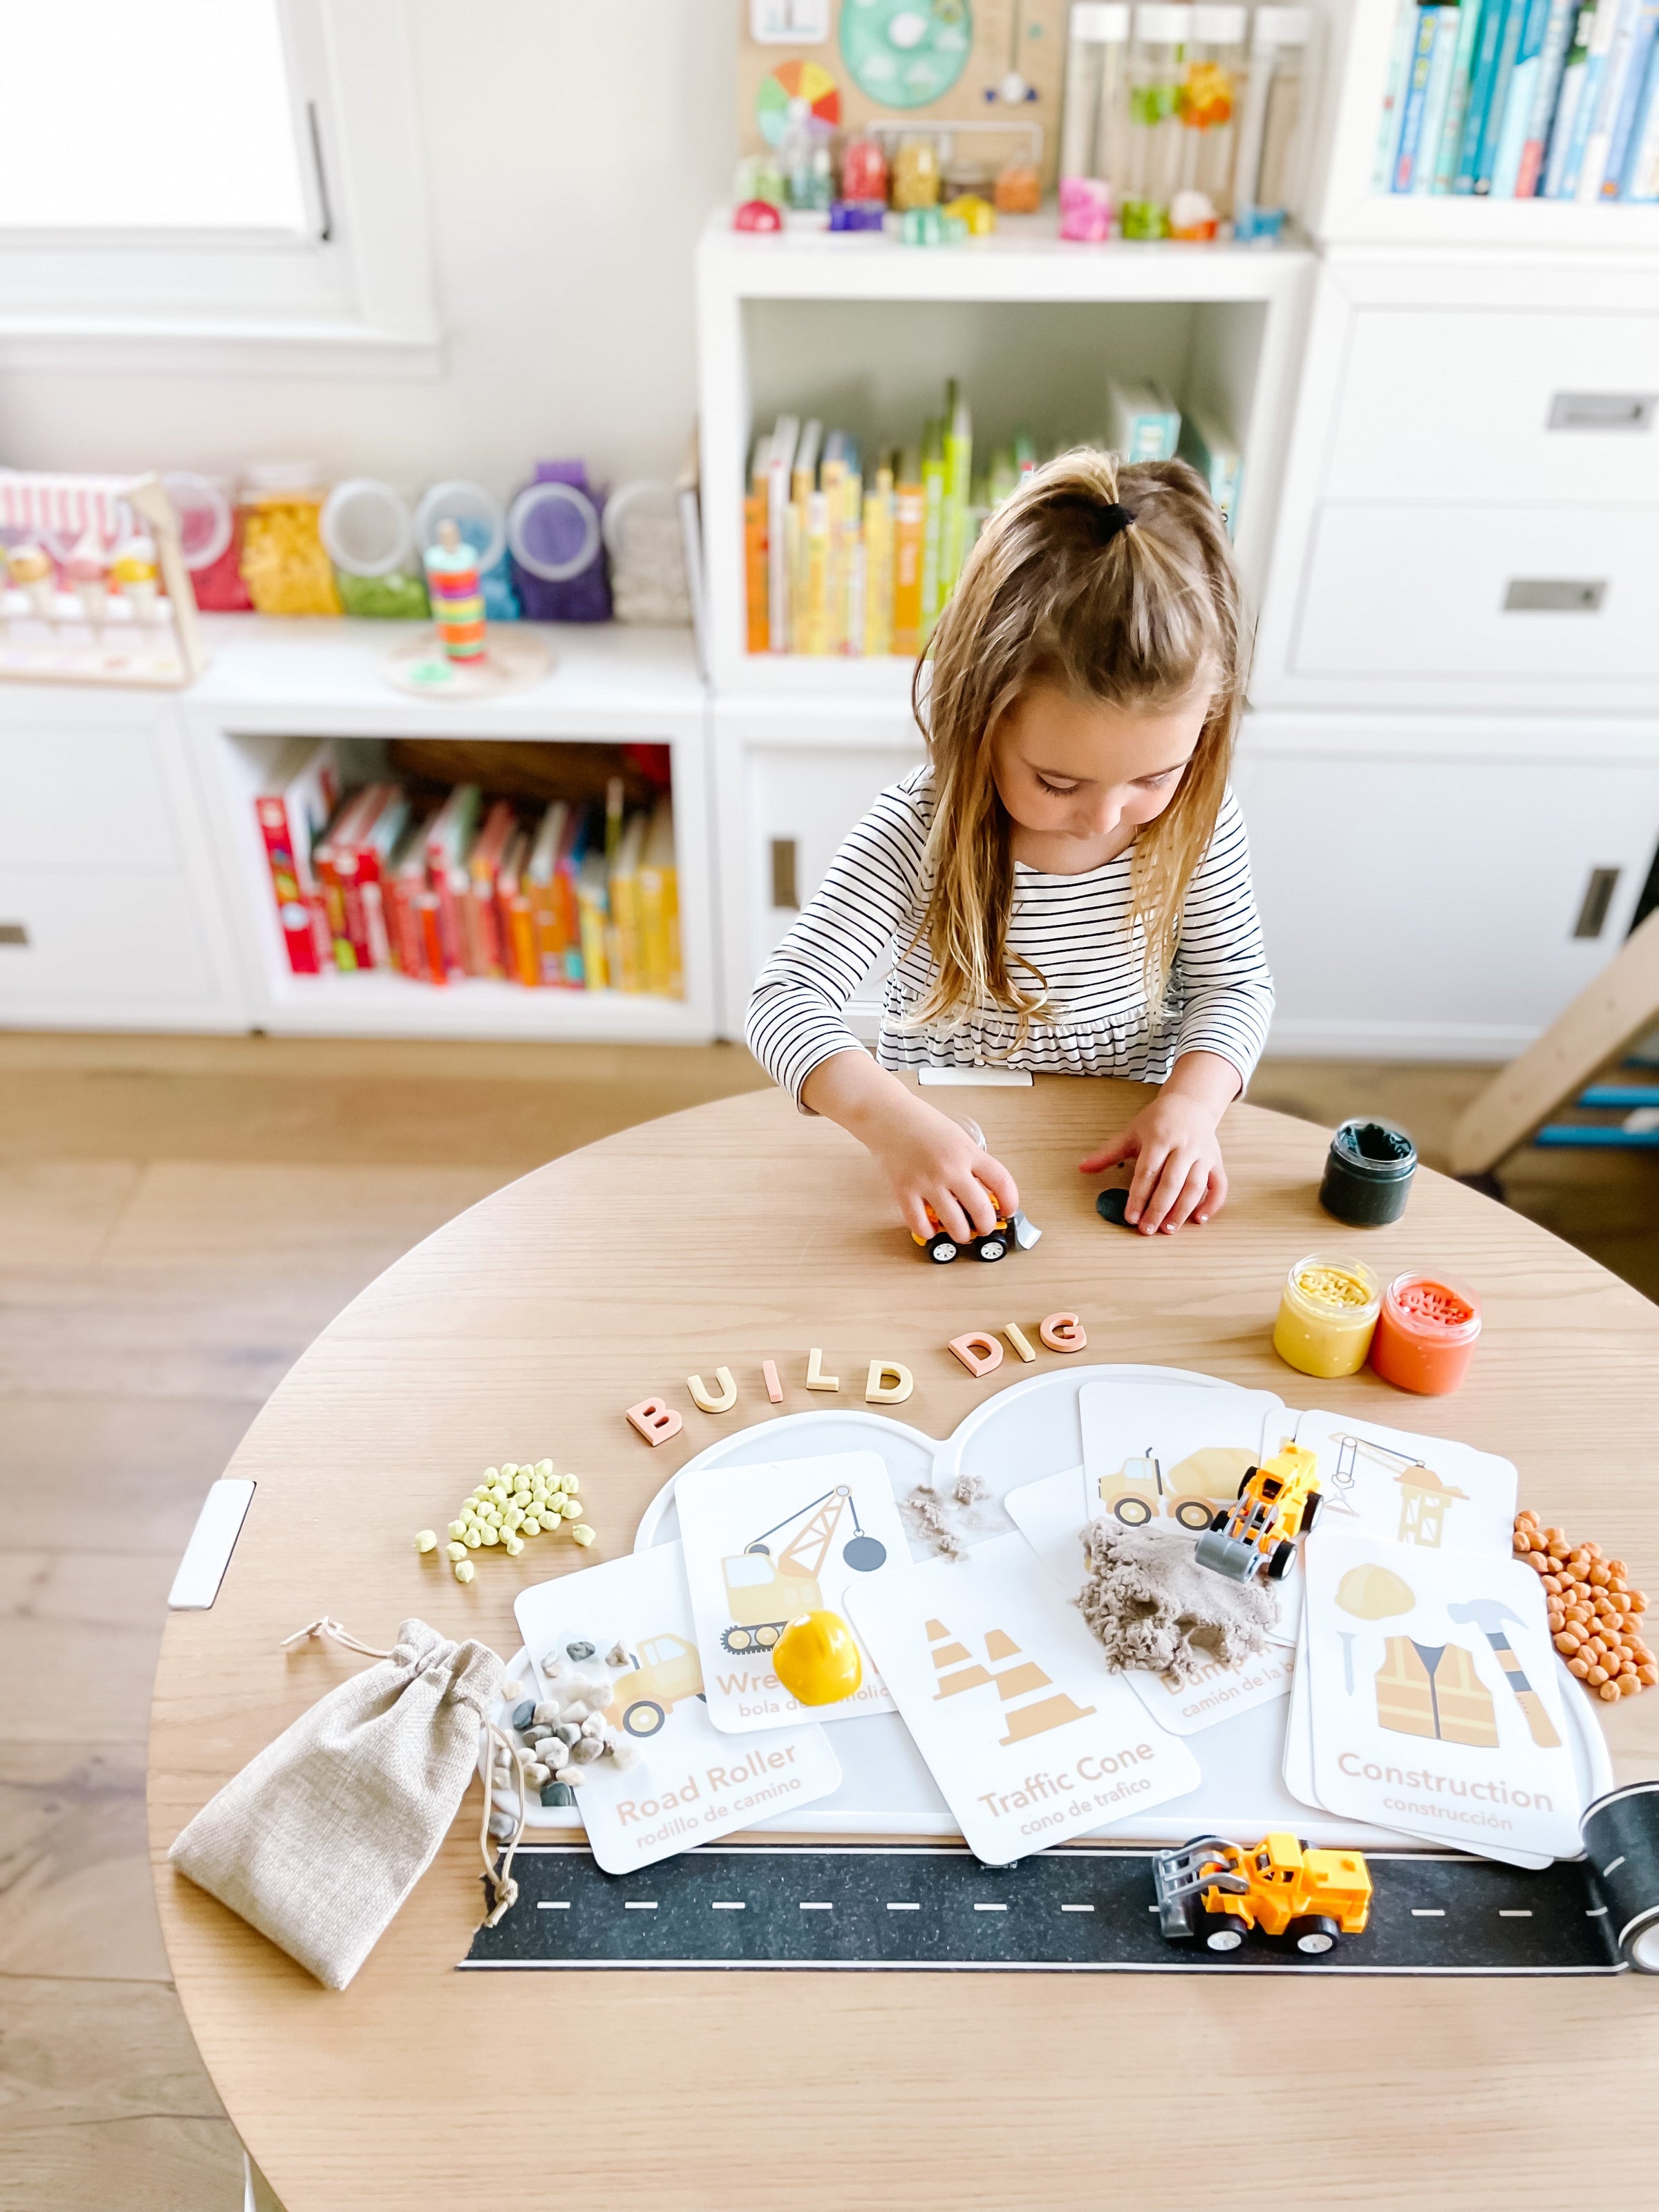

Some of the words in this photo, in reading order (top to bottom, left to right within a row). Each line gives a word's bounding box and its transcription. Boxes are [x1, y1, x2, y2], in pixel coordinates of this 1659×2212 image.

[626, 1347, 914, 1447] BUILD
[948, 1312, 1087, 1378] DIG
[738, 1699, 779, 1717] bola
[1182, 1687, 1240, 1717] camión
[1242, 1676, 1264, 1691] de
[1262, 1668, 1280, 1680] la
[616, 1775, 700, 1826] Road
[706, 1745, 796, 1792] Roller
[977, 1772, 1075, 1817] Traffic
[1076, 1743, 1154, 1781] Cone
[1020, 1812, 1065, 1835] cono
[1068, 1800, 1093, 1817] de
[1094, 1779, 1151, 1806] trafico
[1338, 1752, 1553, 1812] Construction
[636, 1817, 698, 1849] rodillo
[704, 1805, 729, 1822] de
[733, 1779, 801, 1811] camino
[1383, 1797, 1513, 1831] construcción
